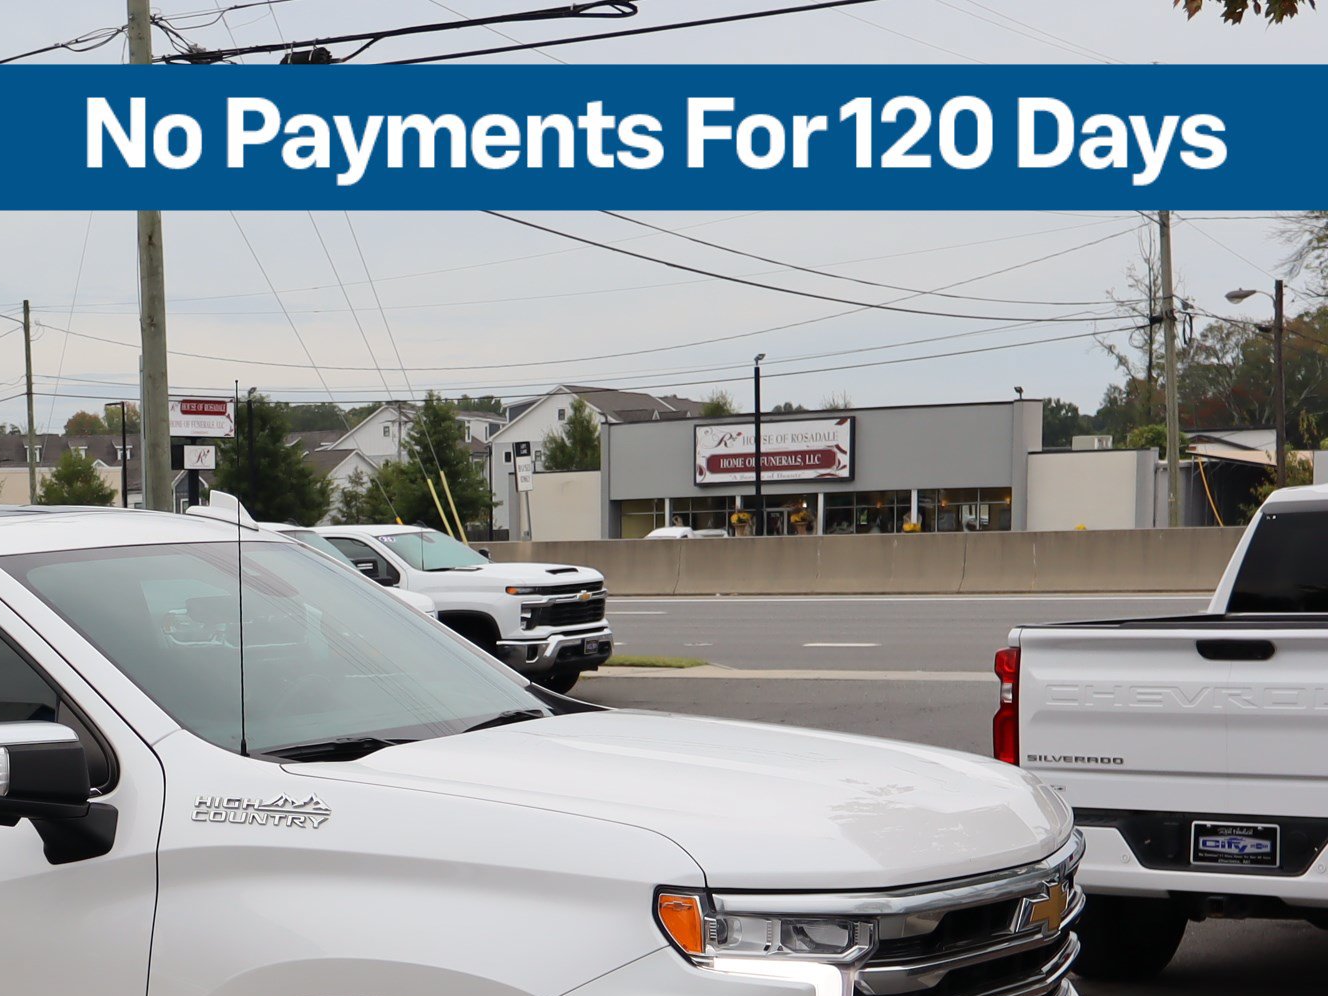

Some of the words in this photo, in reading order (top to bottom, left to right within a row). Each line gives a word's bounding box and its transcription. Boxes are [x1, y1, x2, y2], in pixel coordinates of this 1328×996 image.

[742, 434, 772, 446] HOSE
[775, 433, 789, 444] OF
[791, 430, 839, 444] ROSADALE
[720, 457, 745, 469] HOME
[806, 453, 822, 465] LLC
[1026, 754, 1125, 766] SILVERADO
[193, 795, 261, 810] HIGH
[190, 809, 330, 829] COUNTRY
